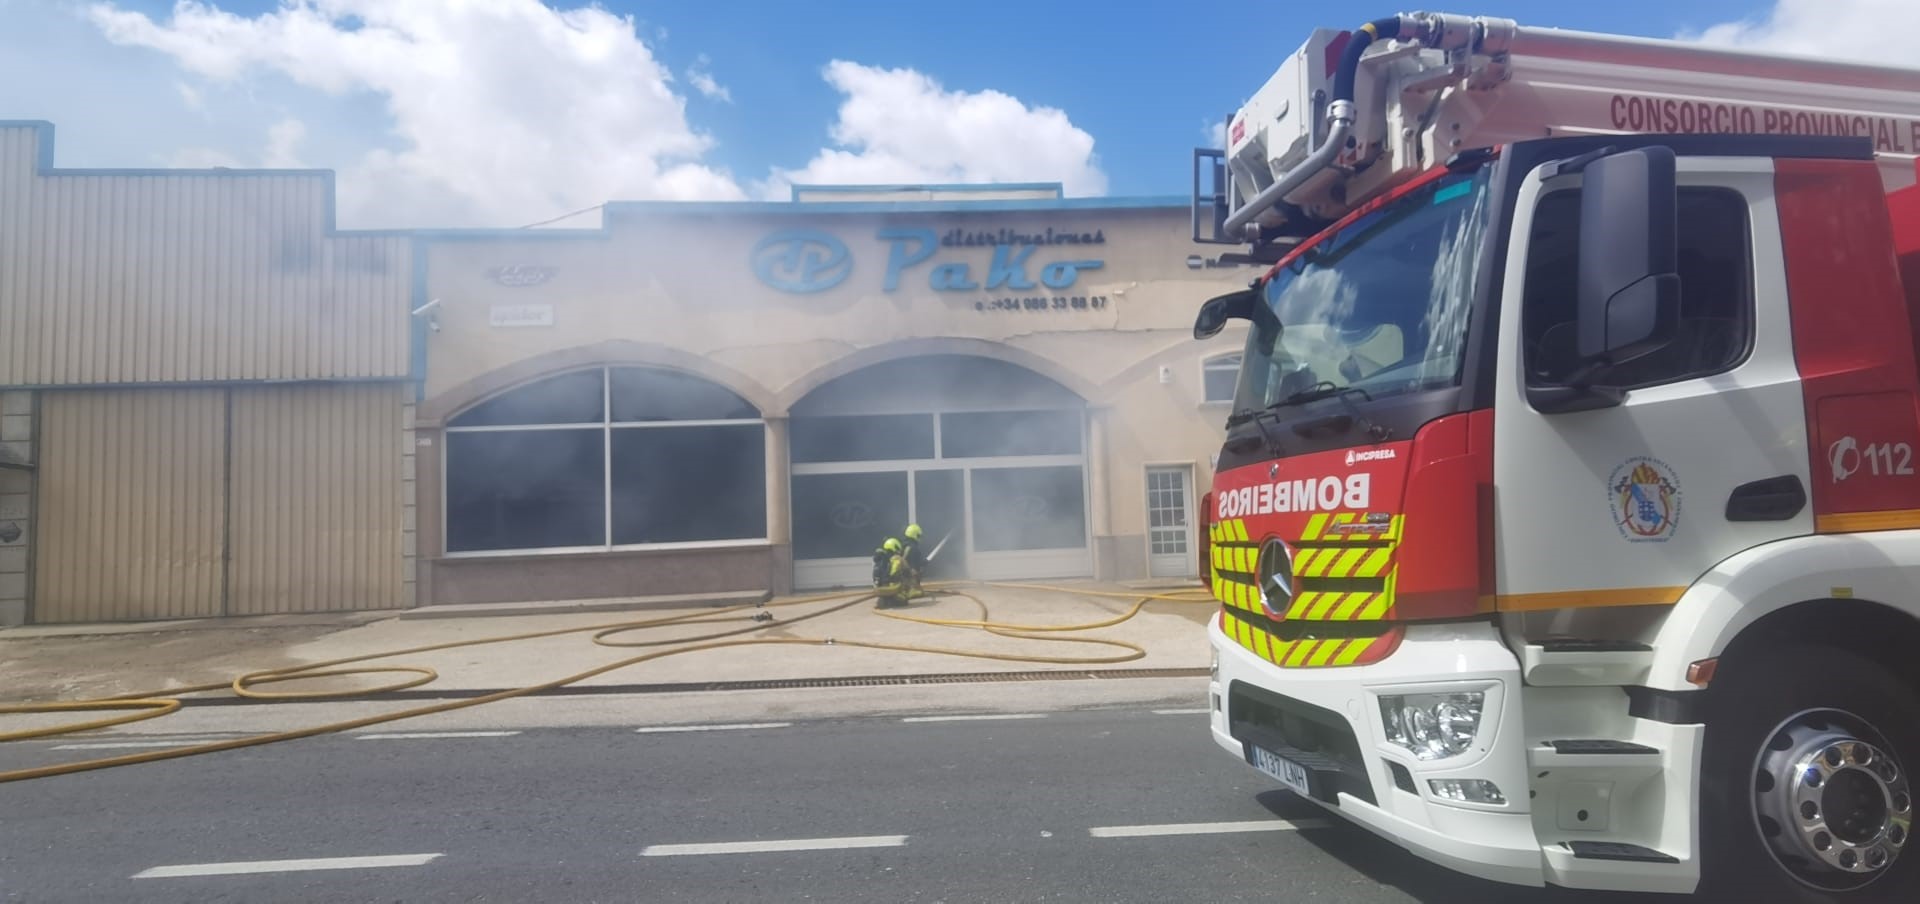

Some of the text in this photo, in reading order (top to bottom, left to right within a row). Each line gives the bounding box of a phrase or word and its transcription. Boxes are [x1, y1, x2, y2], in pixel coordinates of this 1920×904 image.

[1611, 95, 1756, 134] CONSORCIO
[1052, 296, 1067, 309] 33
[1356, 449, 1396, 462] INCIPRESA
[1864, 440, 1914, 476] 112
